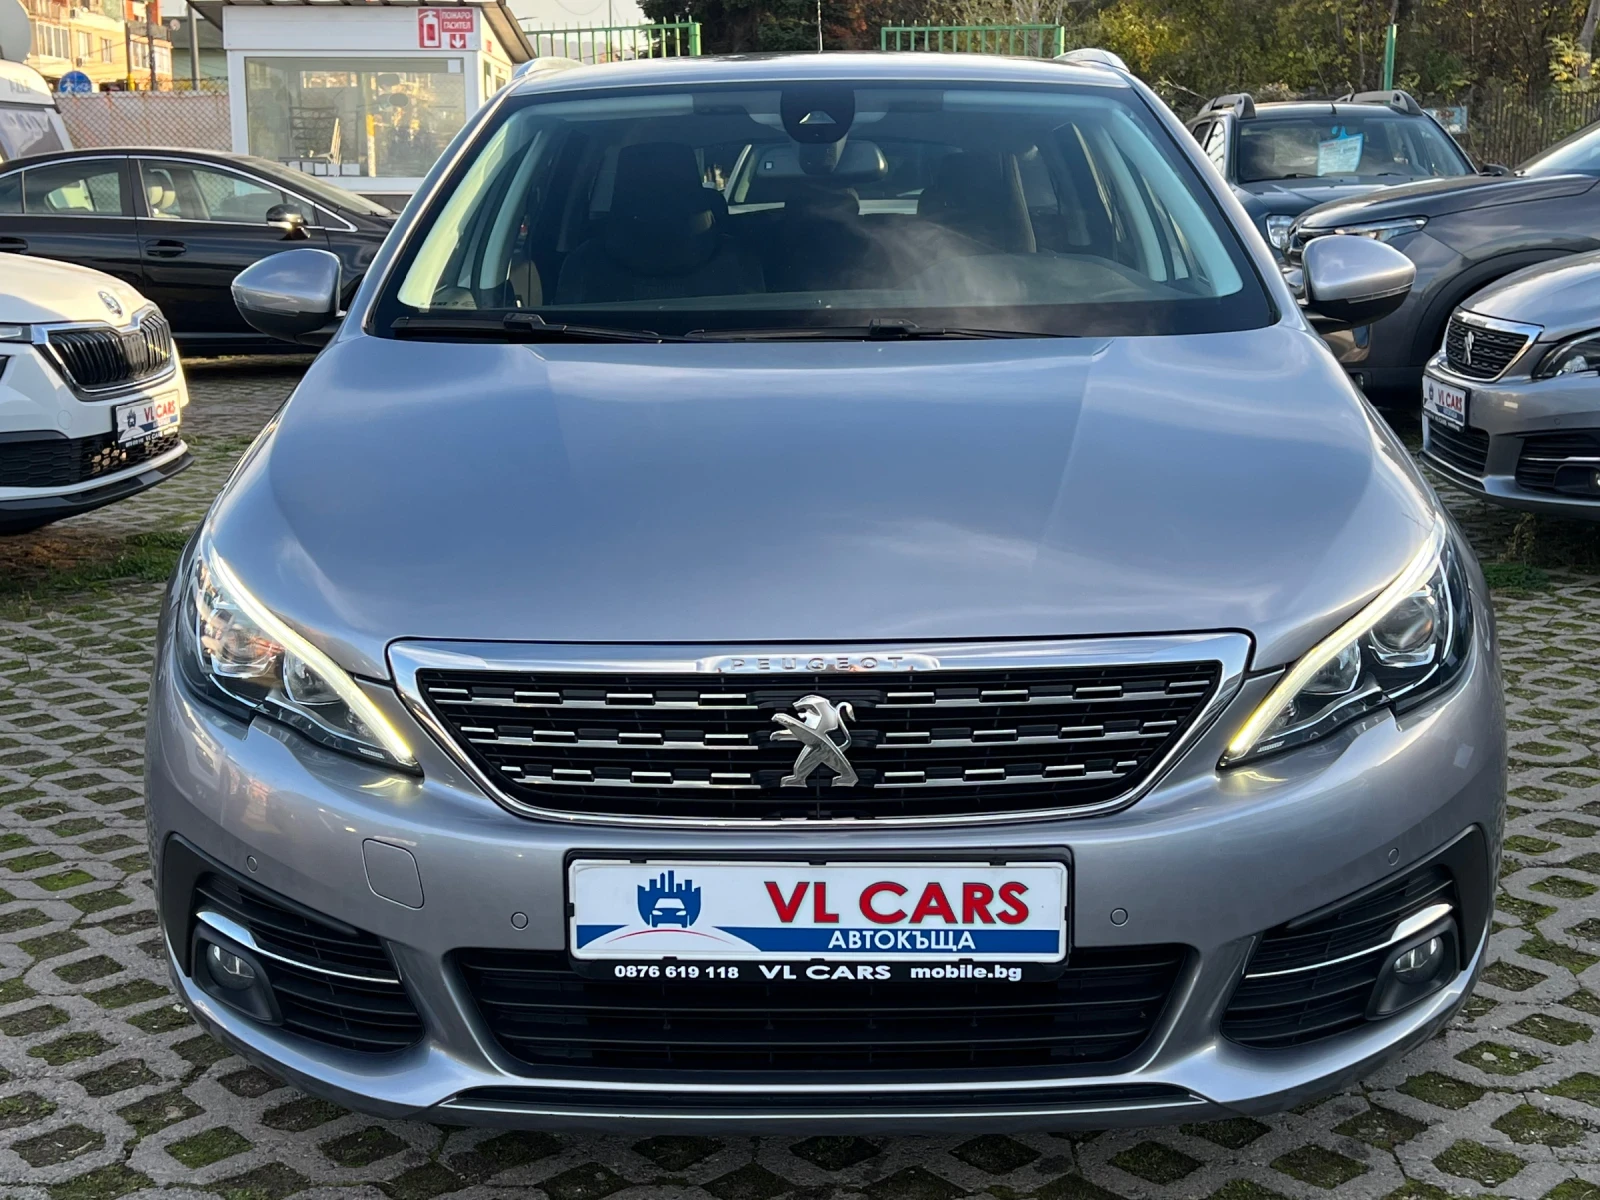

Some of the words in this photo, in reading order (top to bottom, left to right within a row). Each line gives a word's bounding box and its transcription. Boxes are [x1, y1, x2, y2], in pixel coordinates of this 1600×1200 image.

[144, 407, 154, 421] VL
[156, 400, 175, 418] CARS
[1446, 392, 1462, 412] CARS
[730, 657, 903, 671] PEUGEOT
[764, 881, 839, 923] VL
[858, 880, 1030, 925] CARS
[828, 930, 976, 952] АВТОКЪЩА
[614, 965, 660, 978] 0876
[665, 965, 699, 978] 619
[705, 966, 739, 979] 118
[758, 965, 797, 979] VL
[805, 965, 891, 980] CARS
[910, 964, 1022, 982] mobile.bg
